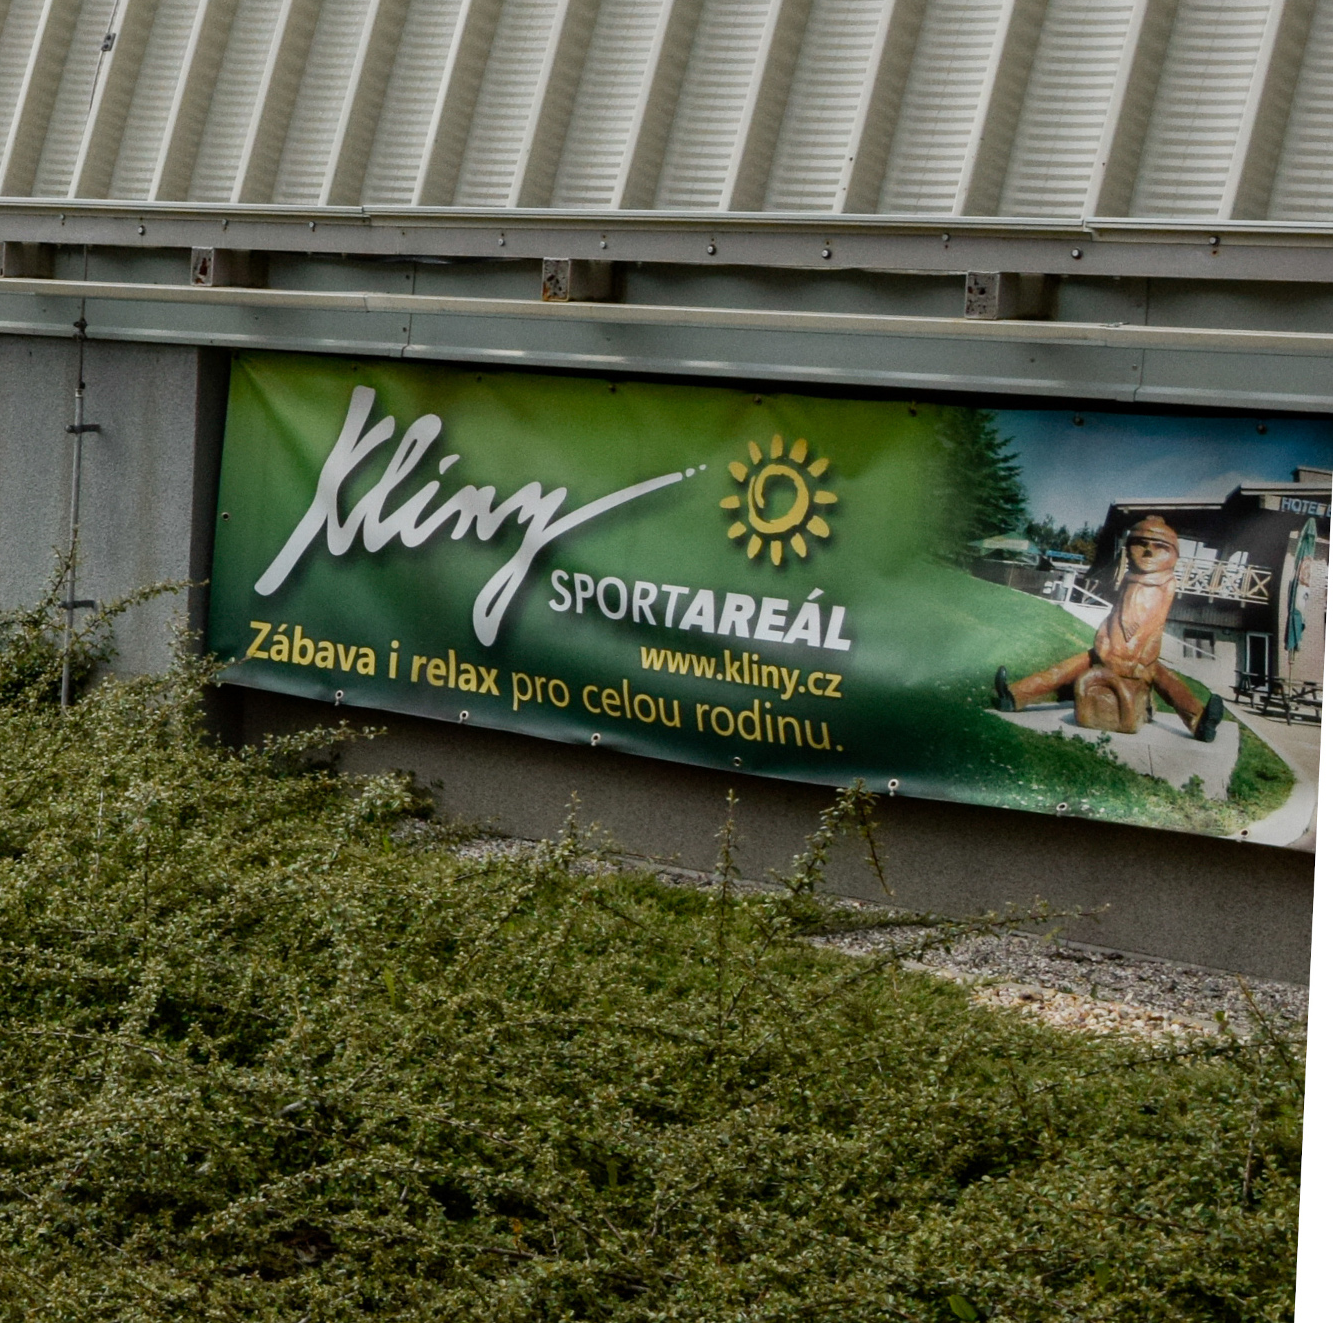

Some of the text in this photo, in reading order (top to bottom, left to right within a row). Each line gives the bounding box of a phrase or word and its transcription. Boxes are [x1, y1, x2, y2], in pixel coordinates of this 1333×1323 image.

[549, 569, 851, 651] SPORTAREÁL
[246, 621, 844, 752] Zábava i relax pro celou rodinu.
[640, 645, 842, 700] www.kliny.cz
